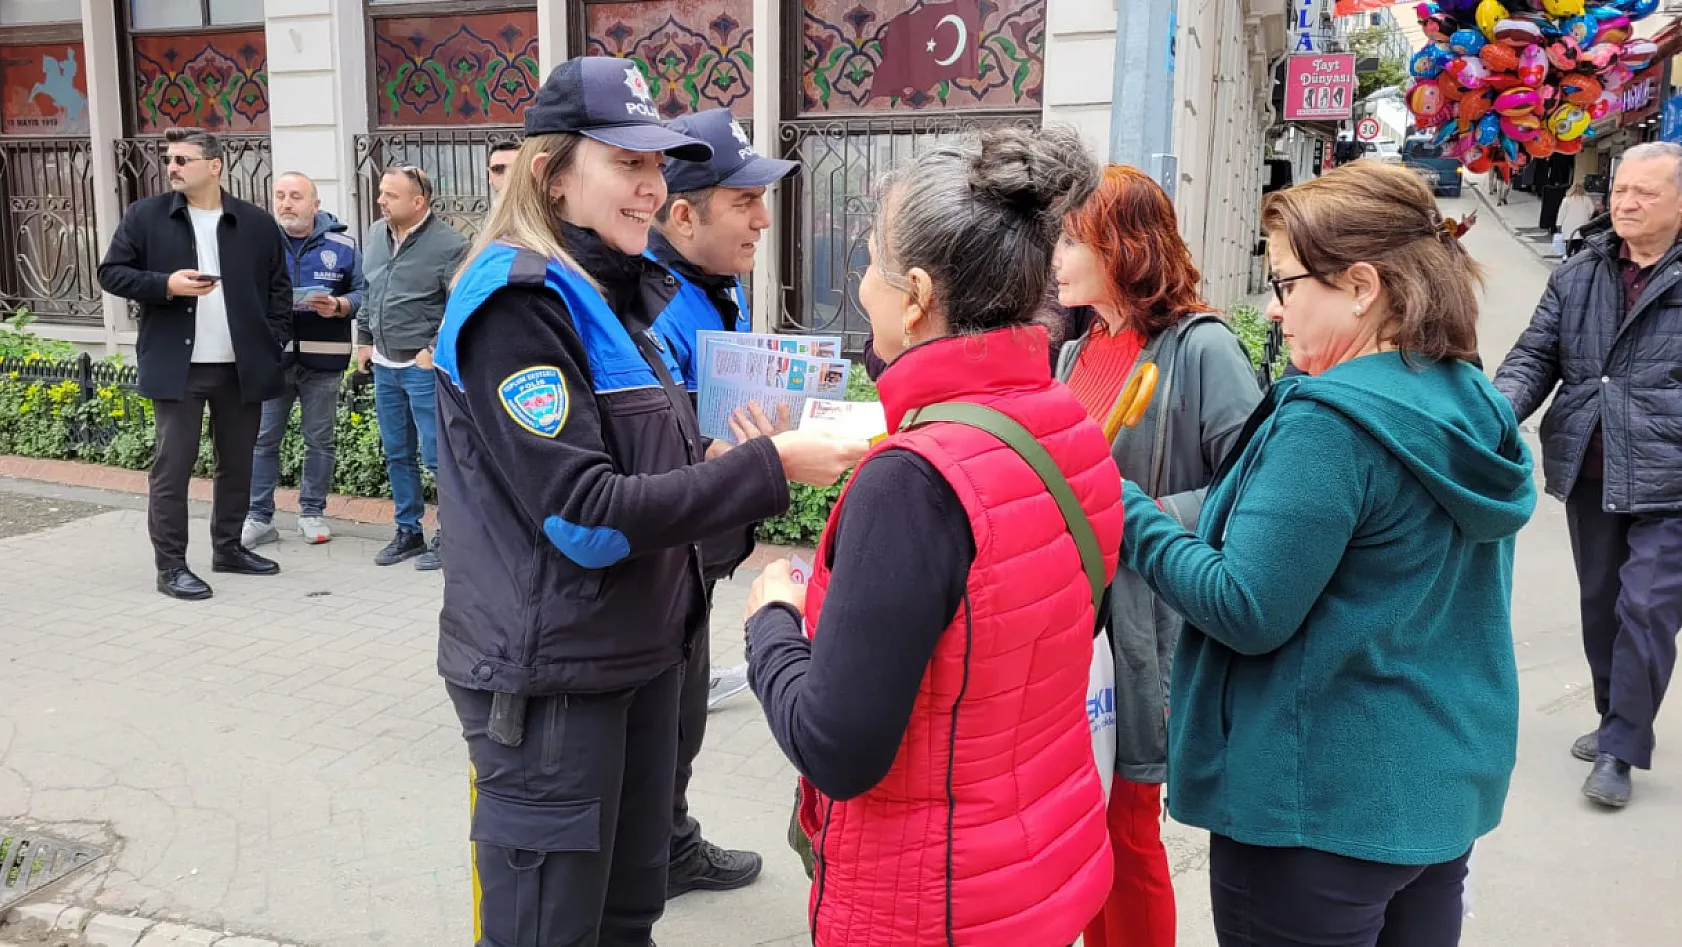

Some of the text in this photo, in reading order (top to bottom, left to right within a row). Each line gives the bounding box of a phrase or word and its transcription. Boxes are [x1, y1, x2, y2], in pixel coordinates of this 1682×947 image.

[1313, 60, 1341, 72] Tayt
[1301, 73, 1350, 86] Dünyası
[1362, 124, 1376, 135] 30
